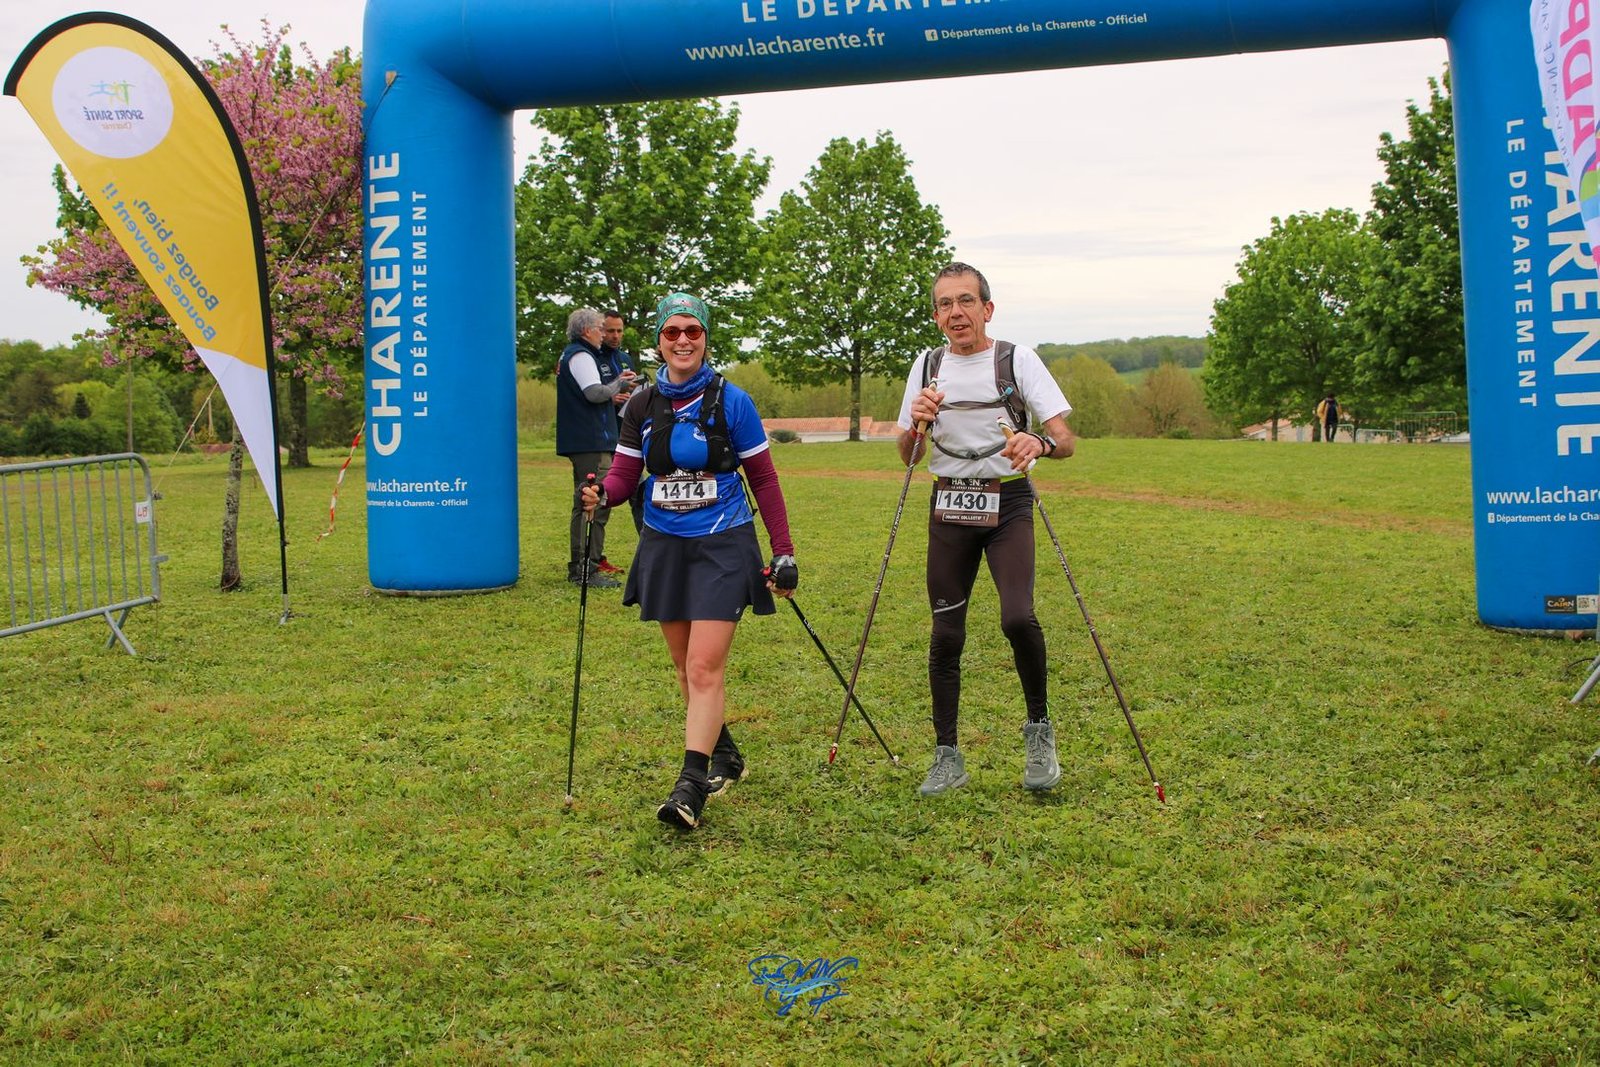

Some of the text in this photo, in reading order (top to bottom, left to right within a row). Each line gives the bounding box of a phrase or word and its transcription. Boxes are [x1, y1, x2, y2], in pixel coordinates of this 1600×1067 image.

[742, 0, 777, 23] LE
[941, 25, 1013, 40] Département
[1016, 22, 1029, 34] de
[1032, 20, 1043, 32] la
[1045, 17, 1096, 31] Charente
[1106, 13, 1147, 25] Officiel
[686, 28, 885, 61] www.lacharente.fr
[1506, 118, 1537, 407] LE DÉPARTEMENT
[369, 151, 401, 457] CHARENTE
[410, 191, 428, 418] LE DÉPARTEMENT
[661, 482, 705, 499] 1414
[944, 492, 988, 511] 1430
[1487, 485, 1600, 504] www.lachar
[395, 499, 402, 507] la
[441, 498, 468, 507] Officiel
[1496, 511, 1600, 524] Département de la Cha
